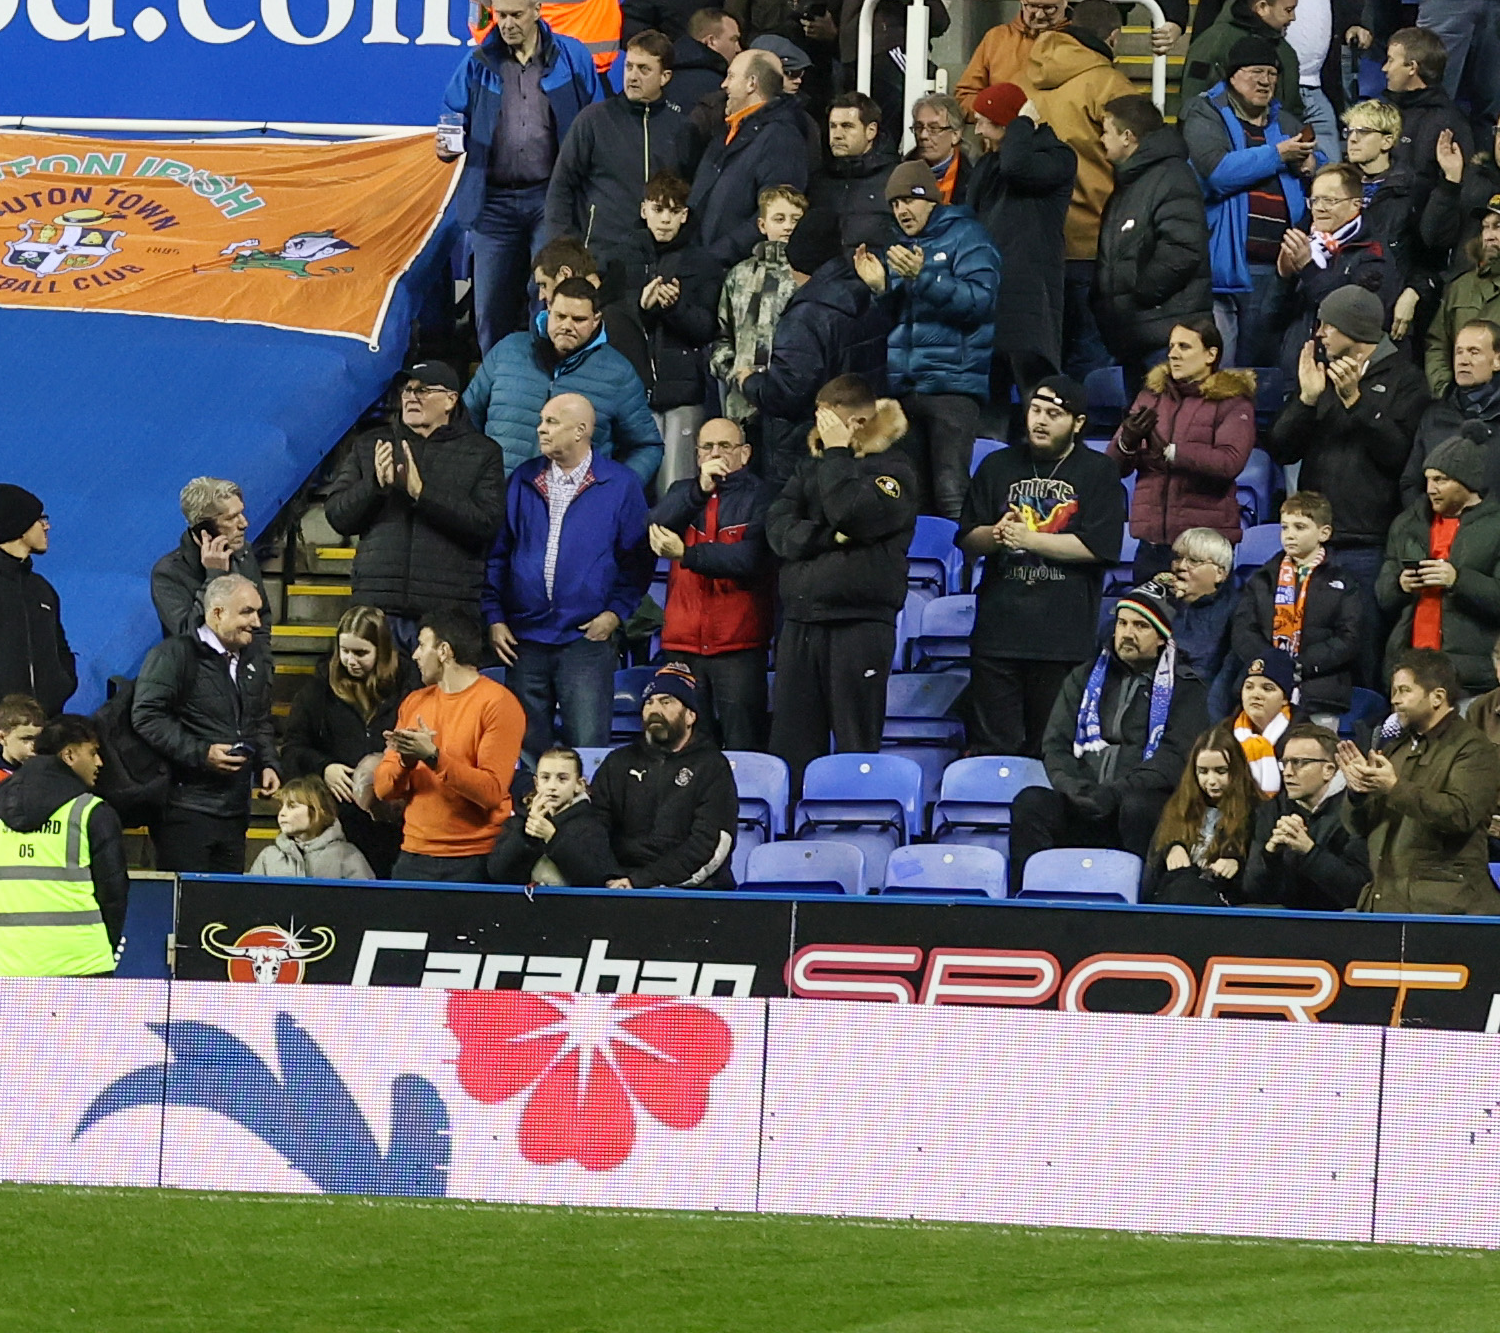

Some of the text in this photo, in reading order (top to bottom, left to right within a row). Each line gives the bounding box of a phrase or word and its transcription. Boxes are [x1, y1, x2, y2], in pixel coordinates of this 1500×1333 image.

[106, 187, 181, 232] TOWN
[72, 263, 146, 292] CLUB
[19, 843, 35, 859] 05
[784, 943, 1470, 1027] SPORT
